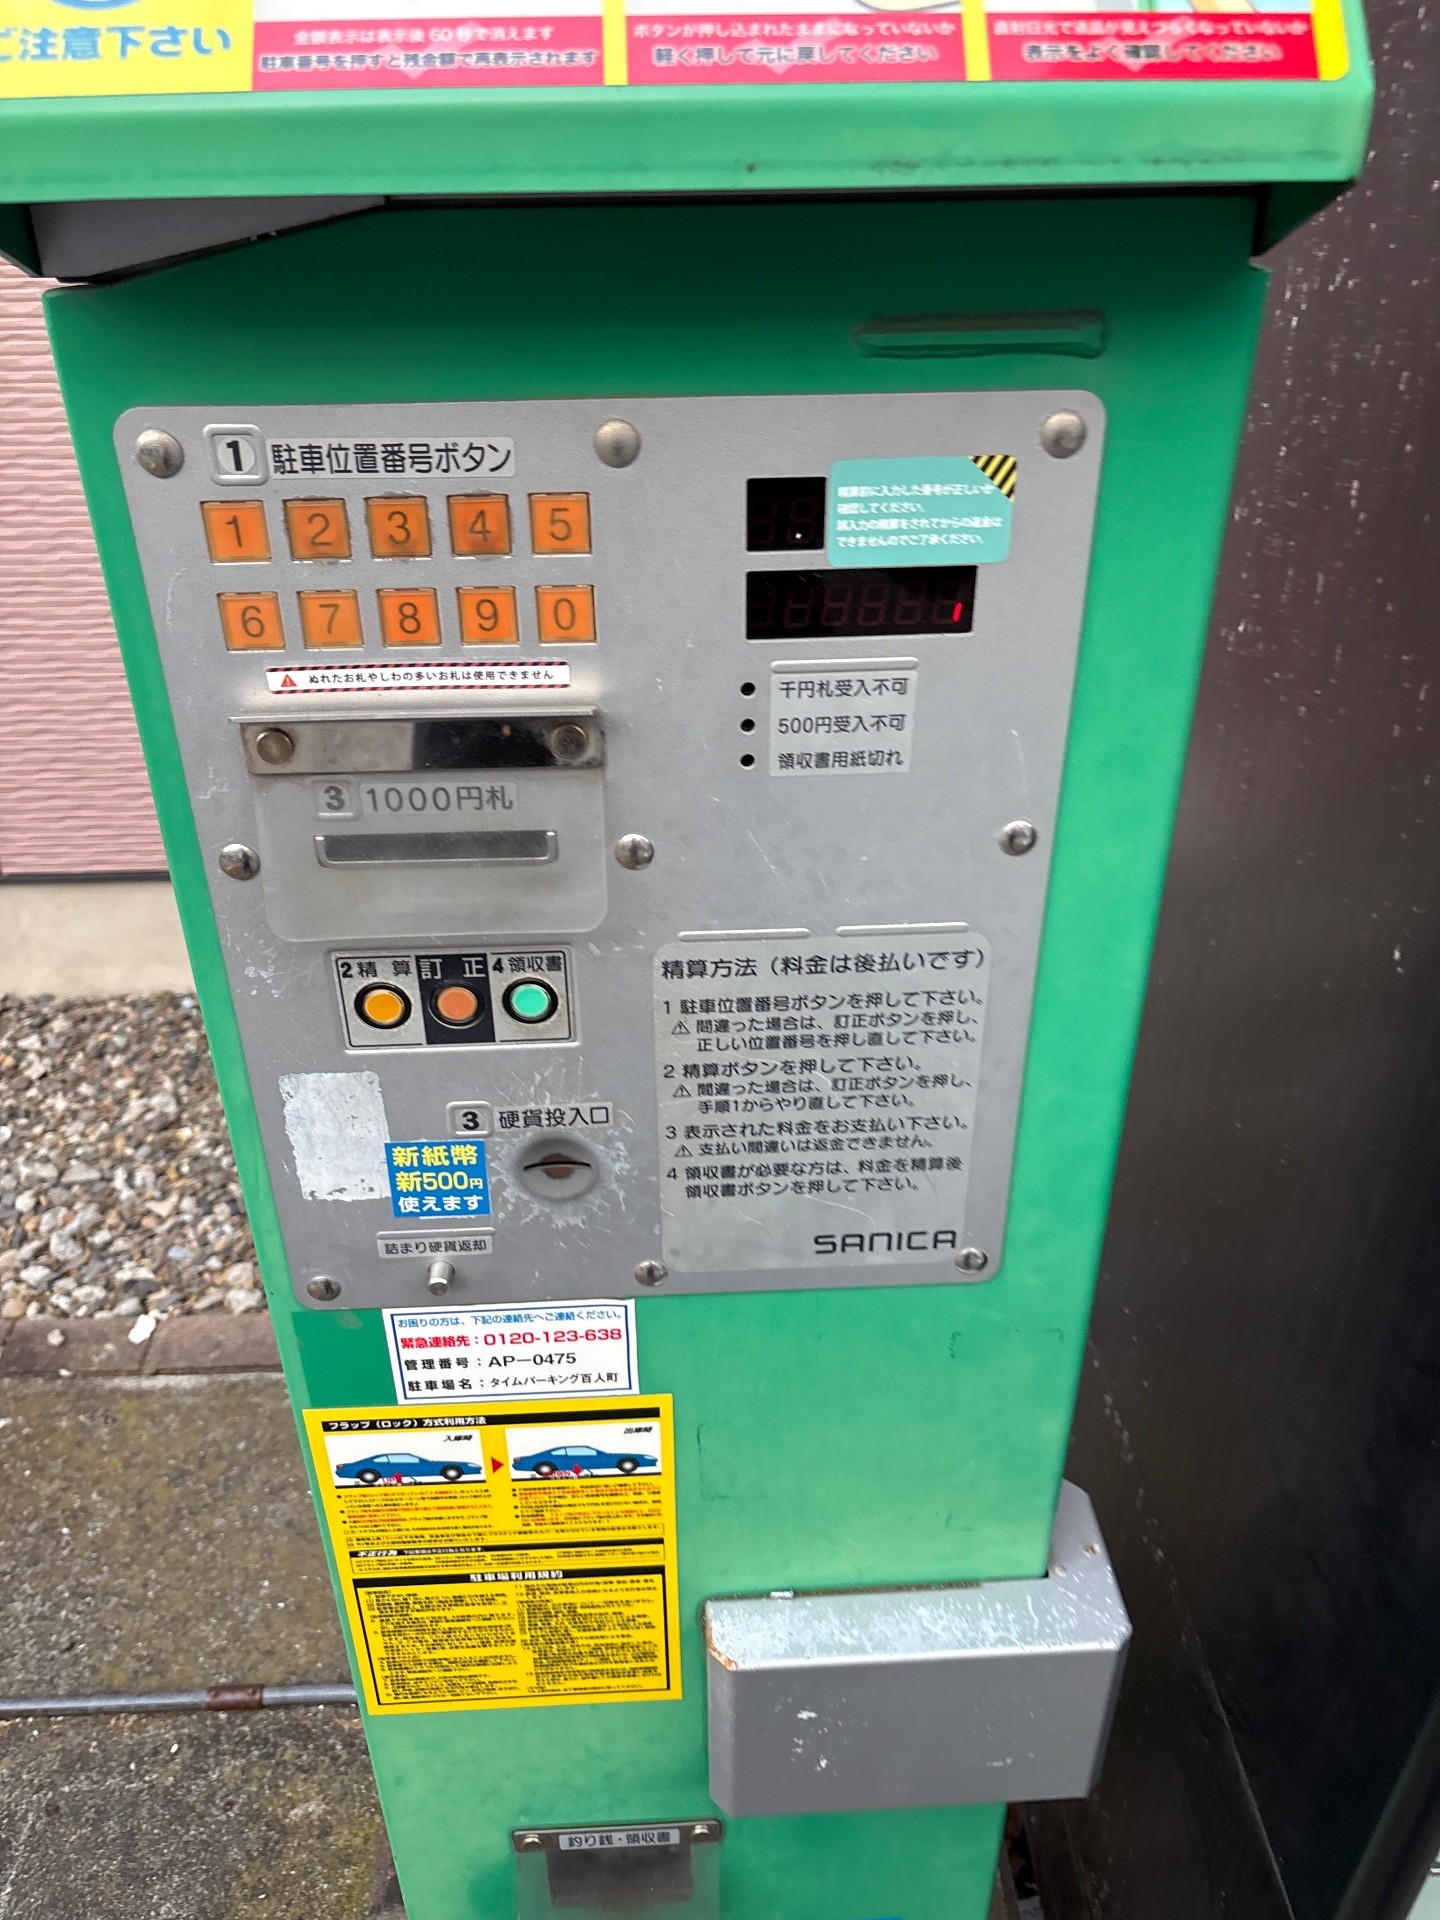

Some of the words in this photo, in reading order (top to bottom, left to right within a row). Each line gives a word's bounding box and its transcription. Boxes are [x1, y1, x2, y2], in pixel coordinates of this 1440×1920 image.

[226, 439, 243, 472] 1
[271, 441, 512, 475] 駐車位置番号ボタン
[225, 515, 244, 548] 1
[307, 513, 333, 547] 2
[387, 511, 411, 545] 3
[468, 510, 491, 542] 4
[550, 507, 573, 541] 5
[241, 605, 266, 638] 6
[318, 603, 341, 634] 7
[398, 601, 422, 634] 8
[475, 598, 499, 631] 9
[553, 597, 577, 631] 0
[308, 669, 554, 685] ぬれたお札やしわの多いお札は使用できません
[778, 677, 909, 699] 千円札受入不可
[777, 713, 907, 735] 500円受入不可
[777, 749, 904, 770] 領収書用紙切れ
[322, 785, 346, 812] 3
[366, 784, 514, 812] 1000円札
[419, 957, 486, 980] 訂正
[697, 1029, 977, 1051] 正しい位置番号を押し直して下さい。
[683, 1056, 922, 1078] 精算ボタンを押して下さい。
[462, 1111, 480, 1130] 3
[499, 1106, 609, 1129] 硬貨投入口
[684, 1115, 968, 1139] 表示された料金をお支払い下さい。
[392, 1144, 478, 1167] 新紙幣
[699, 1134, 933, 1156] 支払い間違いは返金できません。
[395, 1172, 484, 1192] 新500円
[686, 1177, 919, 1199] 領収書ボタンを押して下さい。
[398, 1195, 483, 1213] 使えます
[384, 1239, 487, 1254] 詰まり硬貨返却
[813, 1230, 957, 1255] SANICA
[398, 1309, 622, 1329] お困りの方は、下記の連絡先へご連絡ください。
[568, 1831, 671, 1848] 釣り銭・領収書
